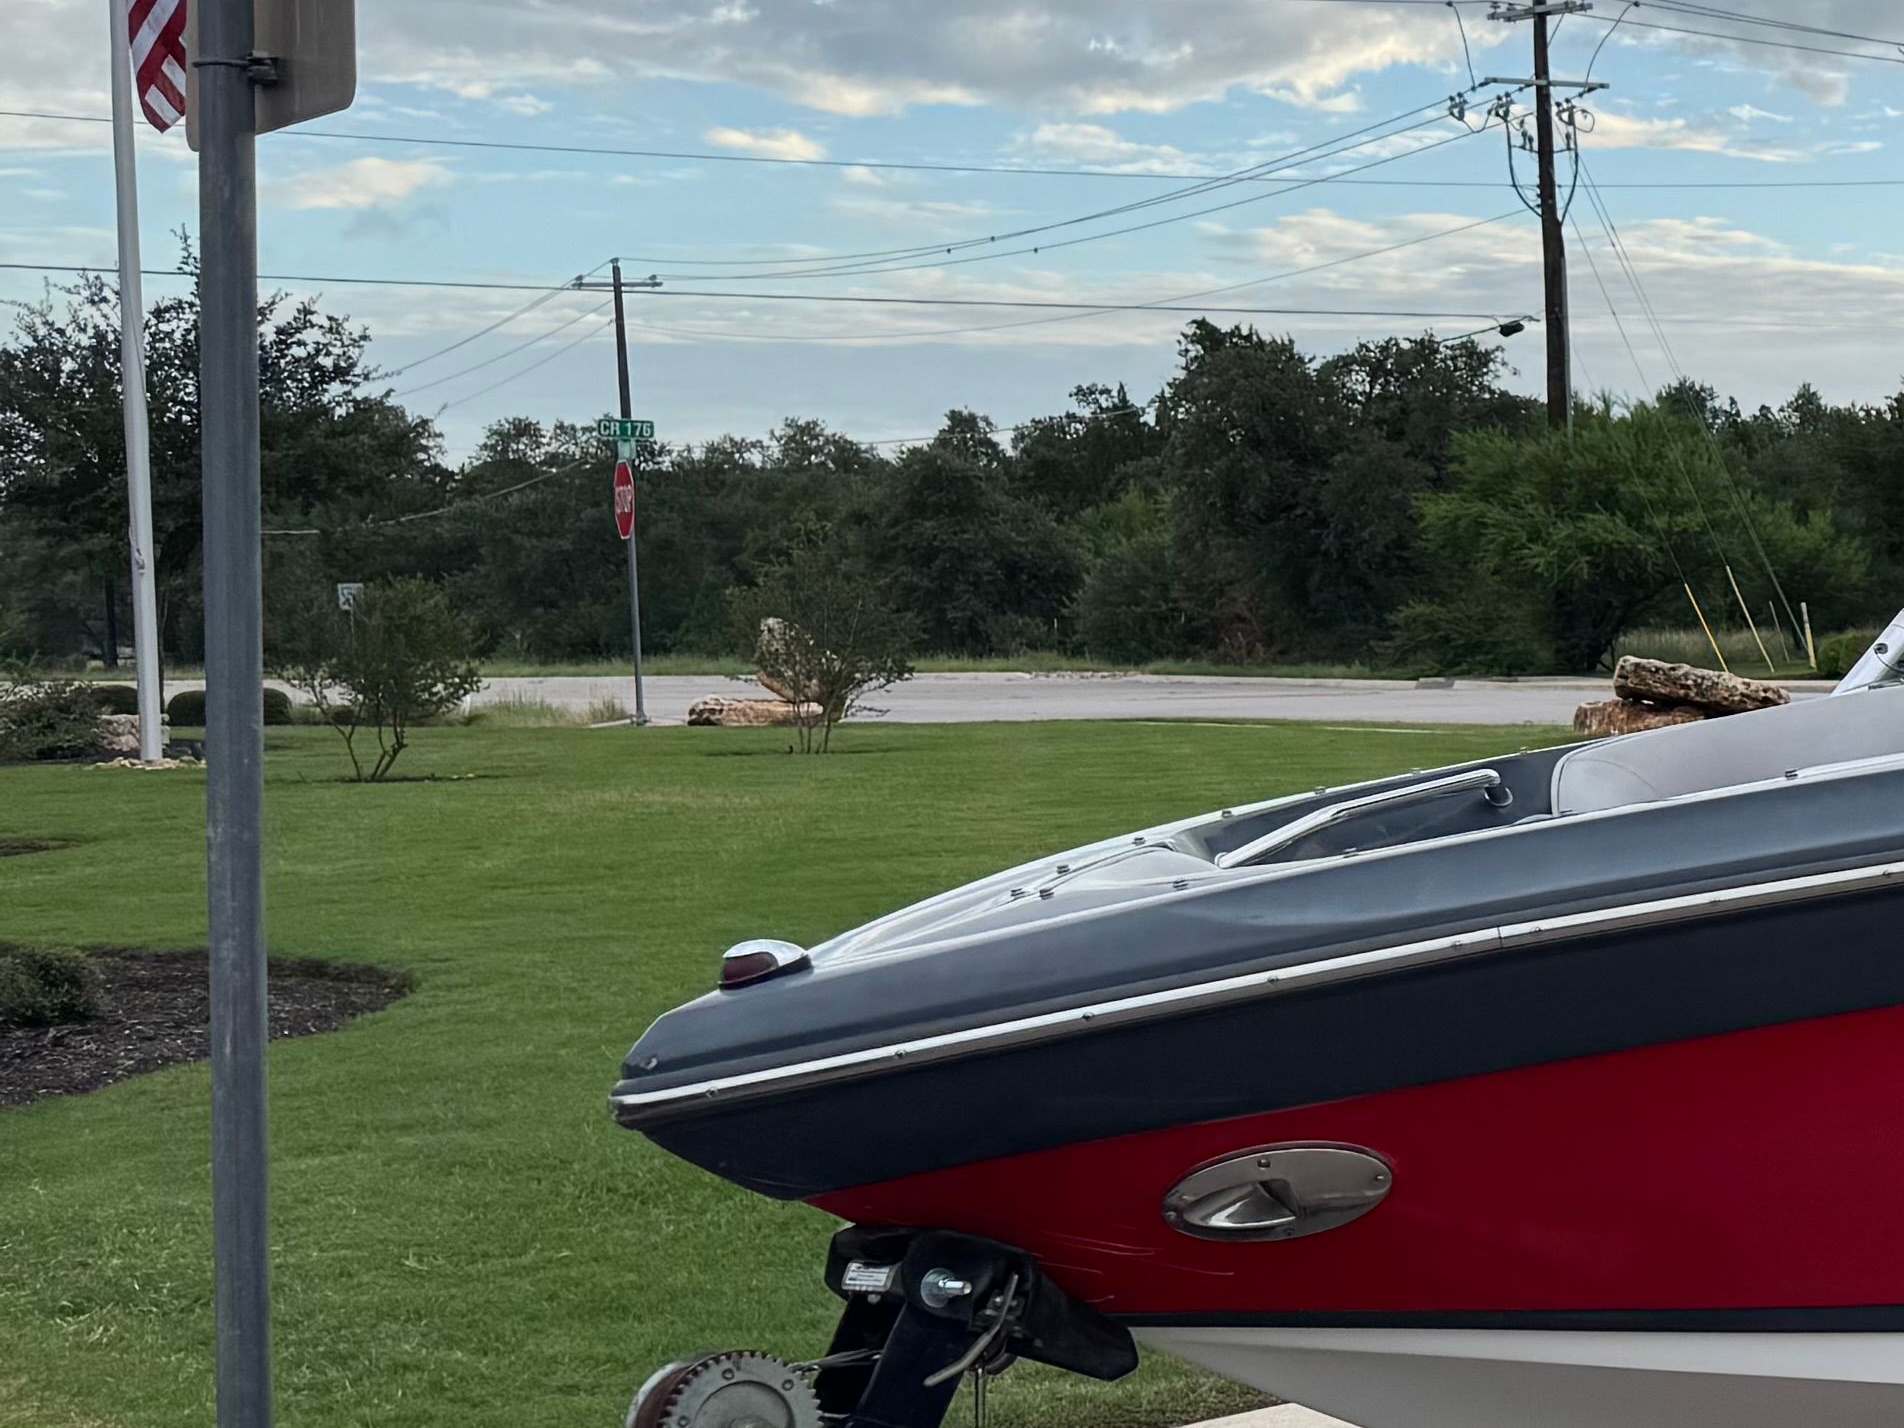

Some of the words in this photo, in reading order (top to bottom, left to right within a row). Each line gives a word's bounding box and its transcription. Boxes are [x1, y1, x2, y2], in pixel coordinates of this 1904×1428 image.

[600, 420, 620, 436] CR
[625, 421, 652, 437] 176
[616, 484, 631, 513] STOP
